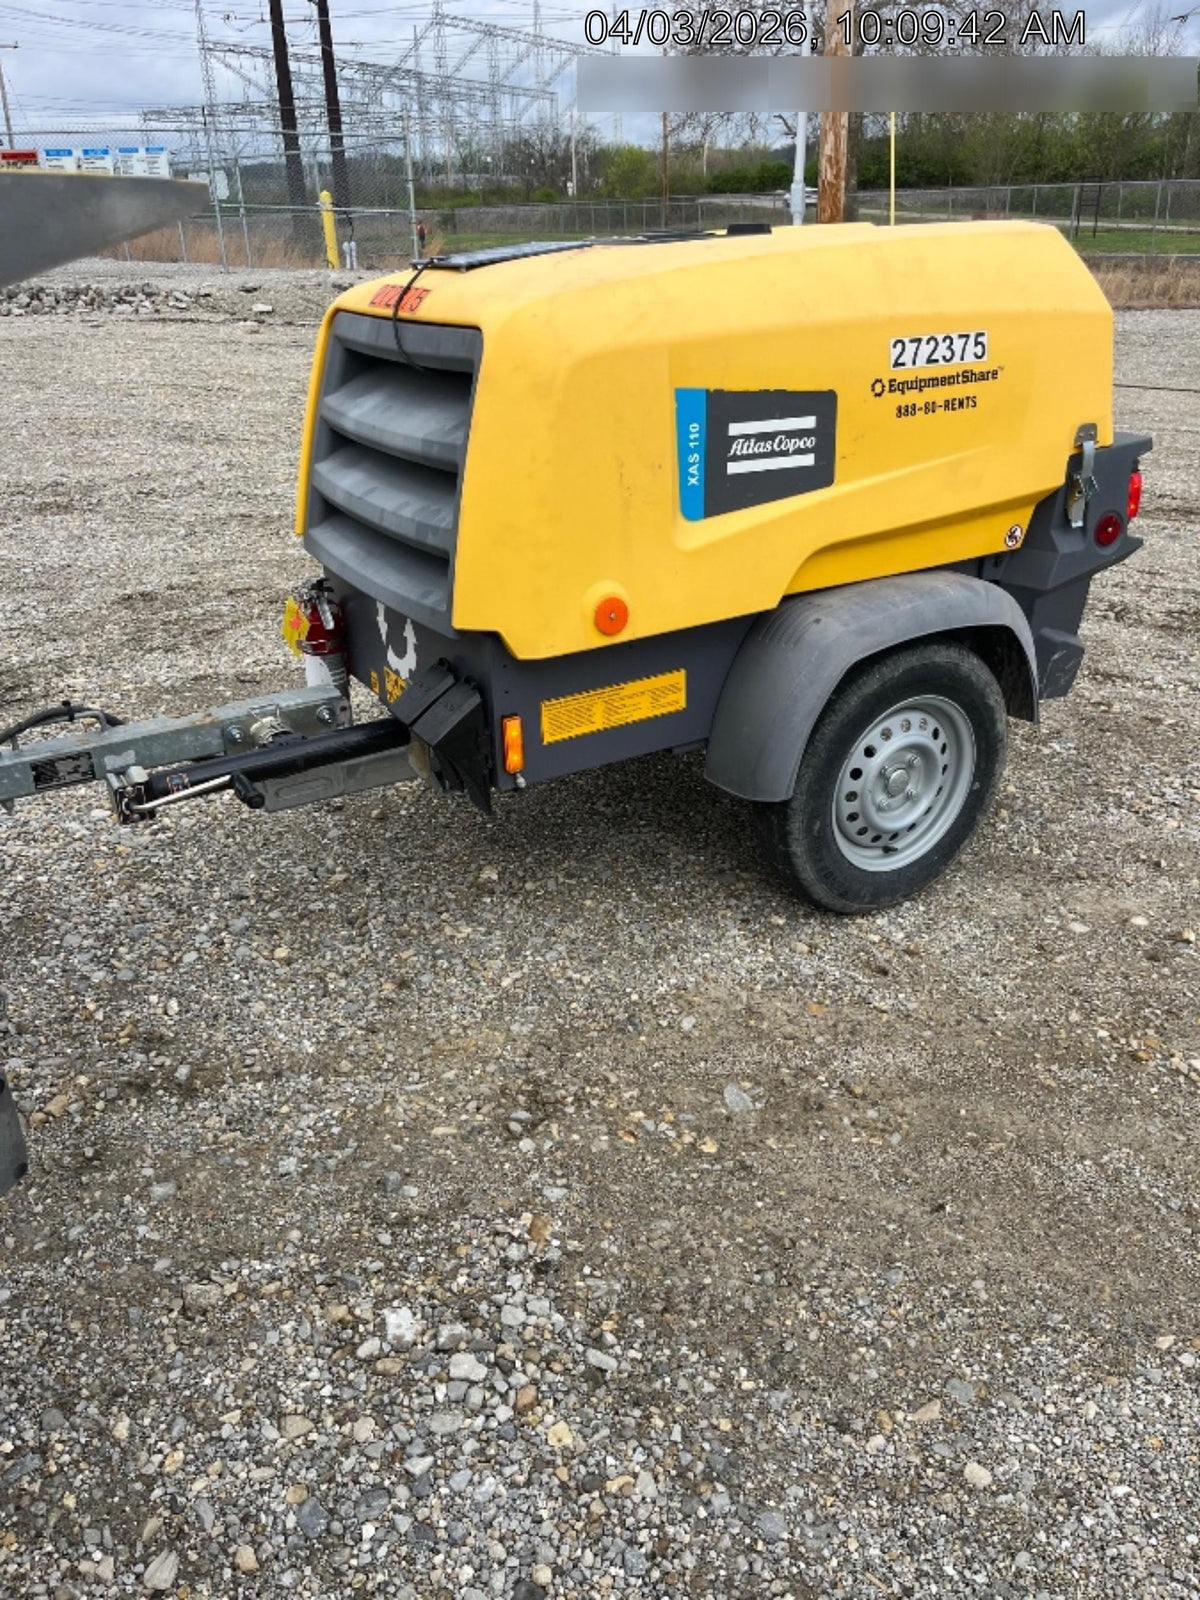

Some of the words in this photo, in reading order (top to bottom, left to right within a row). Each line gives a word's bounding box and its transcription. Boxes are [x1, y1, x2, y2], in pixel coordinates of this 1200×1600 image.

[369, 284, 433, 313] 27275
[891, 332, 987, 369] 272375
[688, 422, 700, 449] 110
[687, 453, 700, 486] XAS
